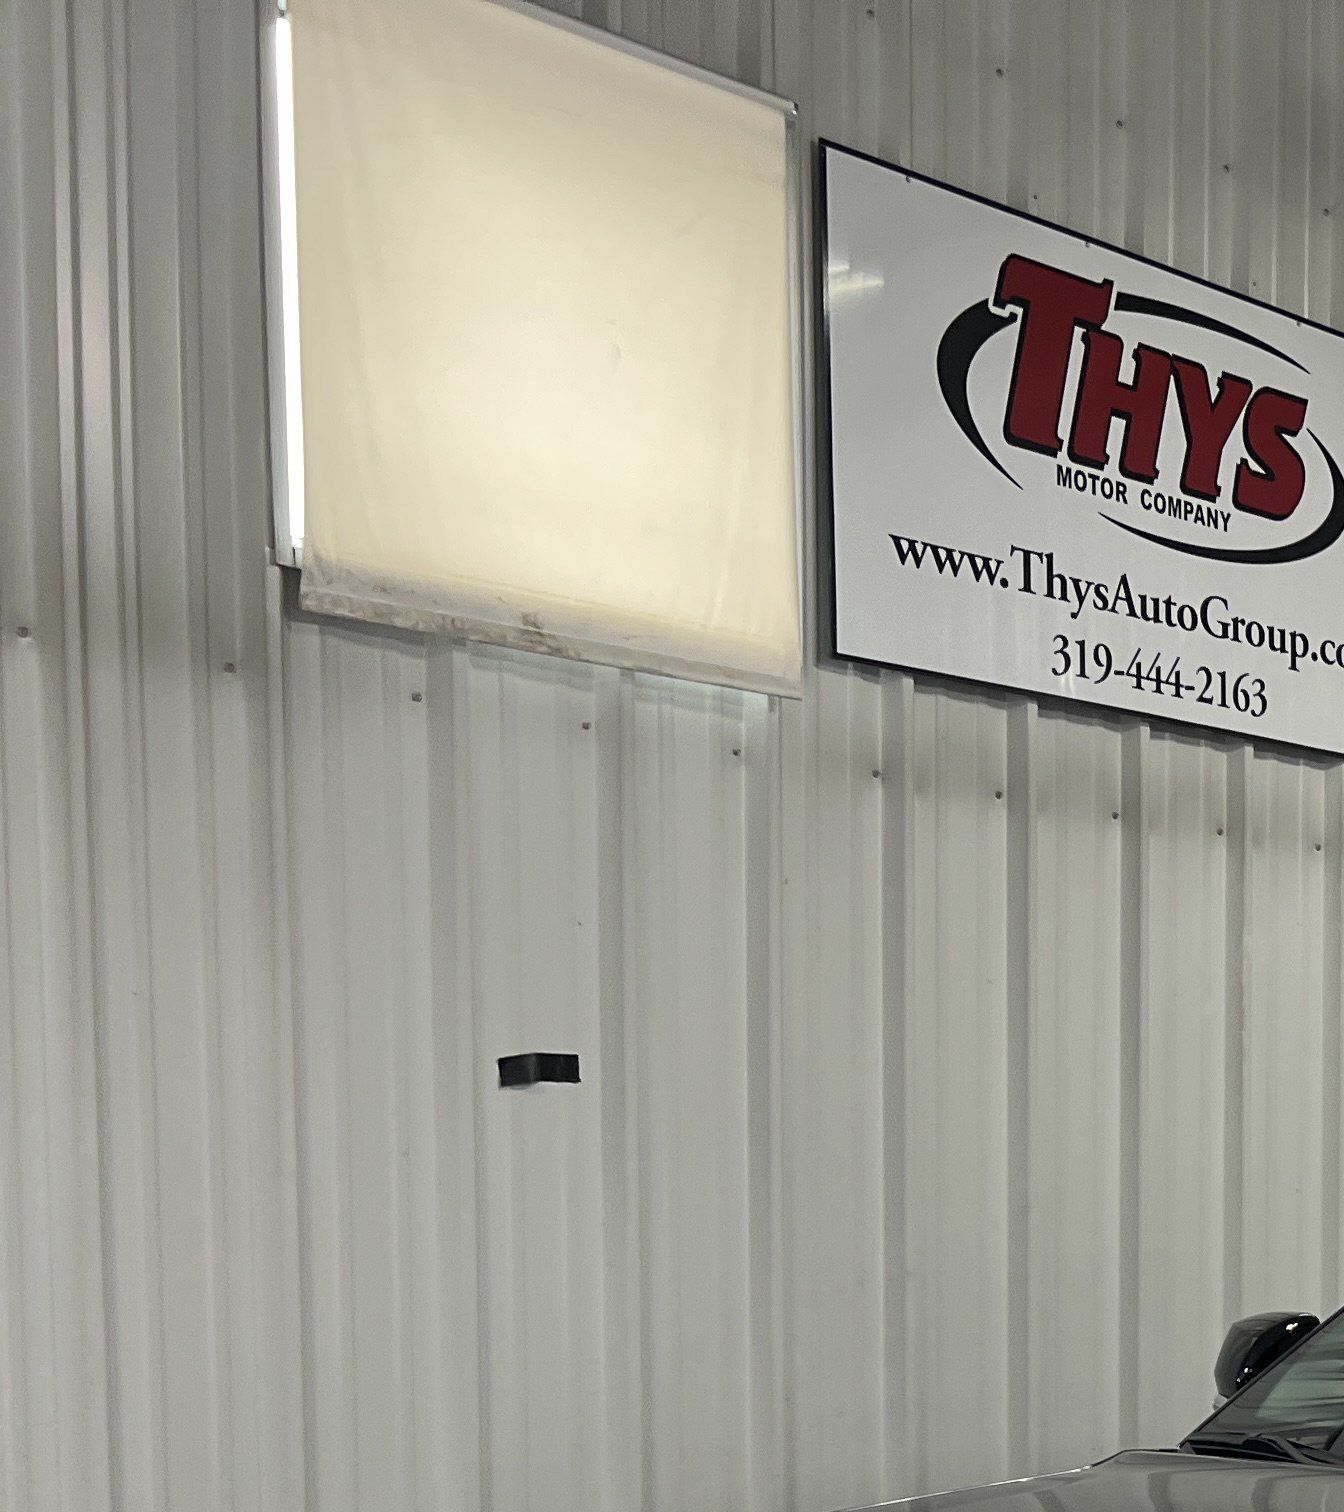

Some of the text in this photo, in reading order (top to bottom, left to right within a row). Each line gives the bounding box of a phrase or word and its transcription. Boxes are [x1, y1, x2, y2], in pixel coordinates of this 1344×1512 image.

[994, 252, 1309, 521] THYS
[1056, 463, 1232, 533] MOTOR COMPANY
[1051, 633, 1269, 717] 319-444-2163
